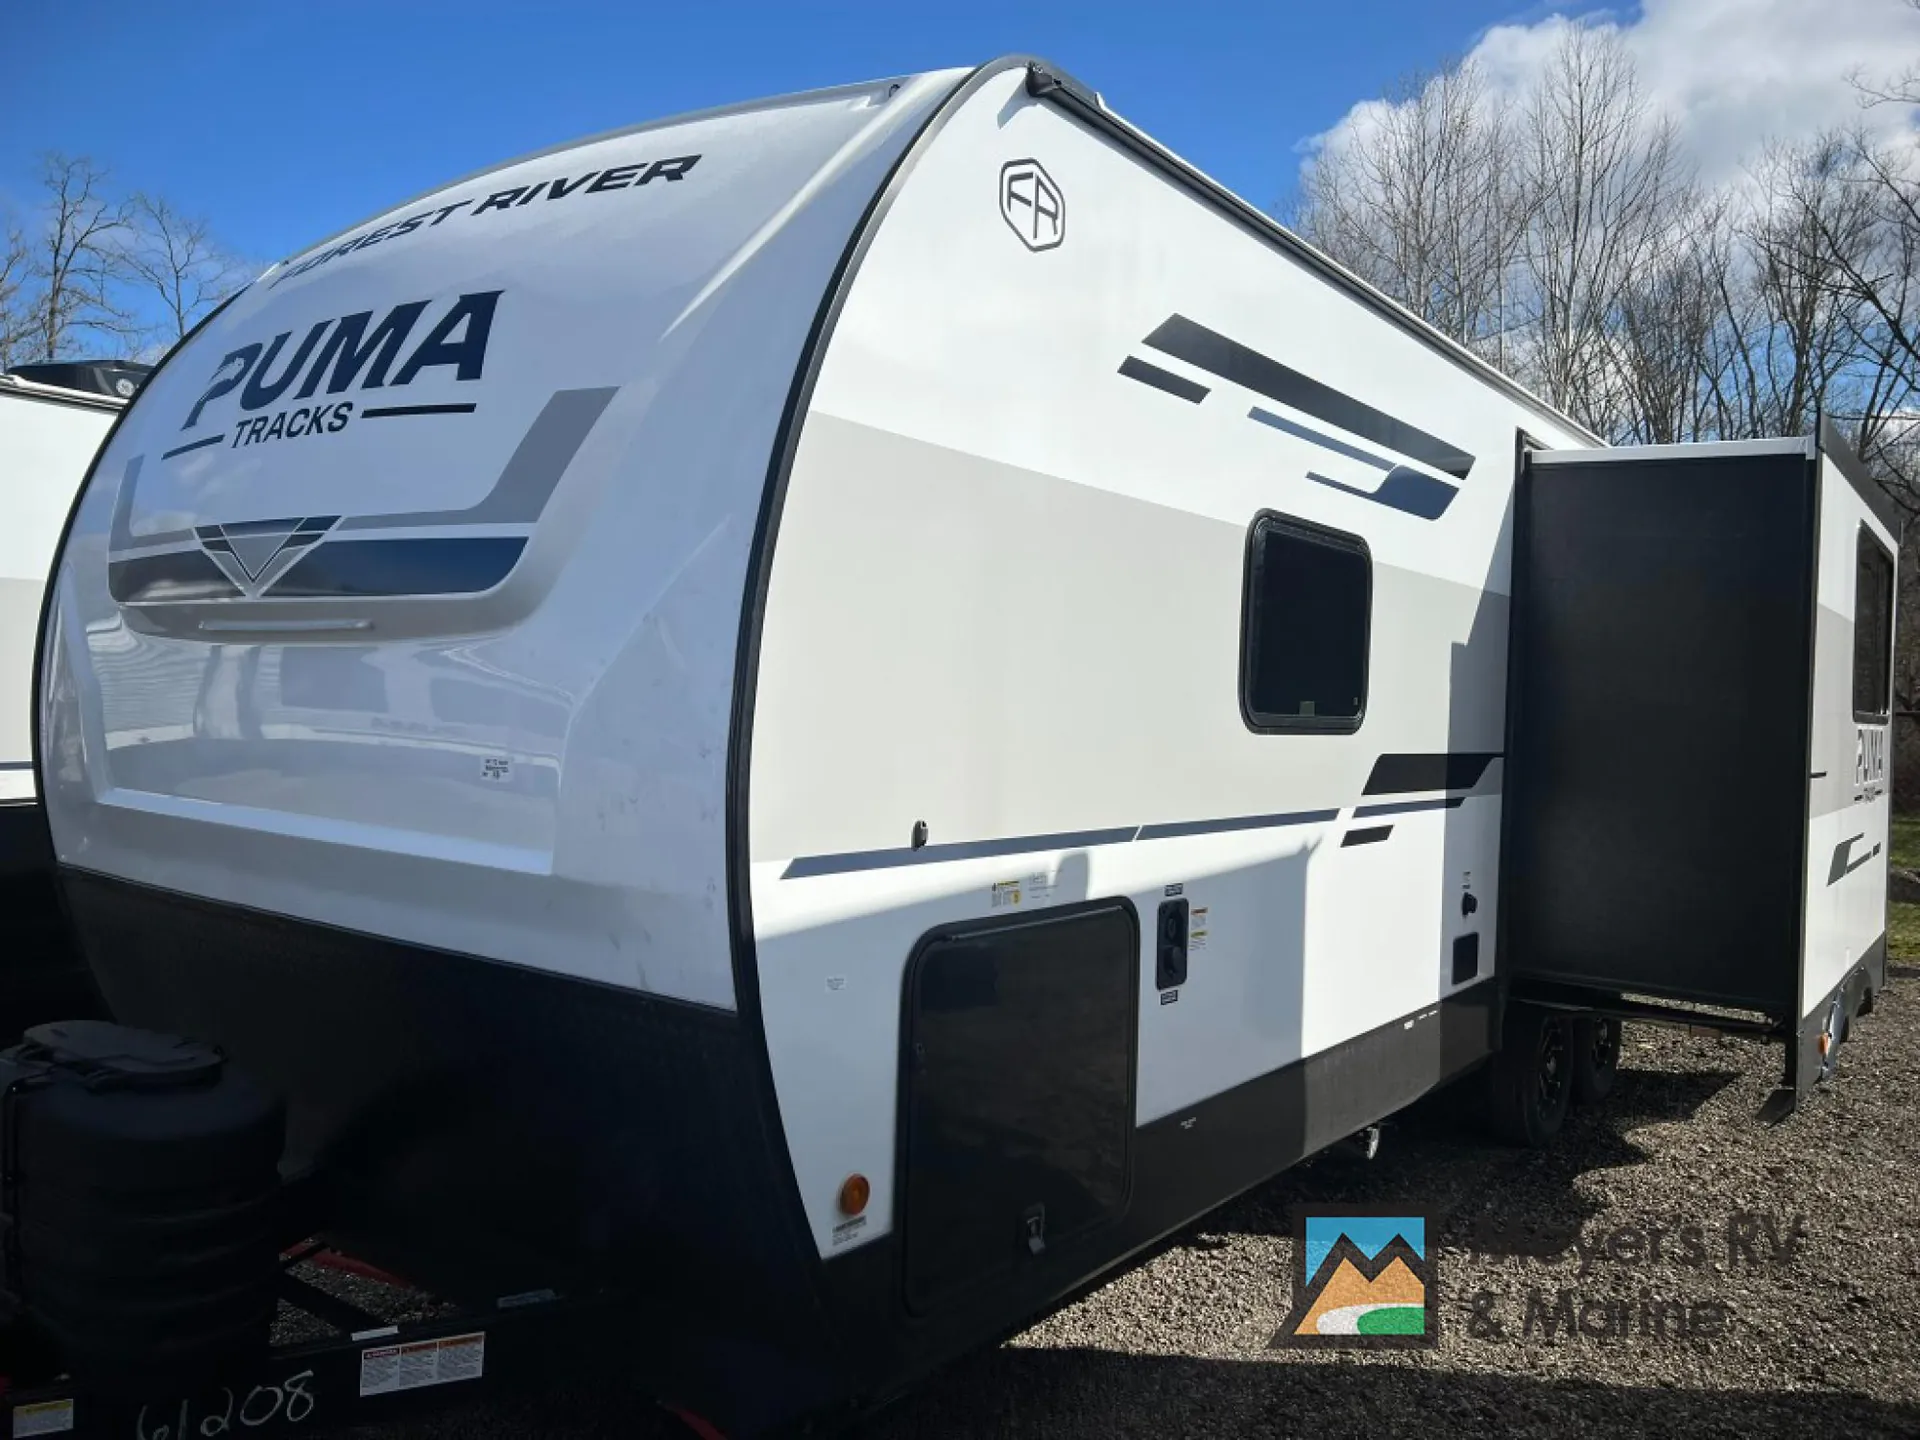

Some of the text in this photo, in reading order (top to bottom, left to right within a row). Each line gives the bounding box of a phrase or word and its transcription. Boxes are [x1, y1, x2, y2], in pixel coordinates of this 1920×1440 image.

[268, 153, 702, 291] FOREST RIVER
[180, 290, 505, 432] PUMA
[232, 402, 353, 448] TRACKS
[1855, 728, 1884, 785] PUMA
